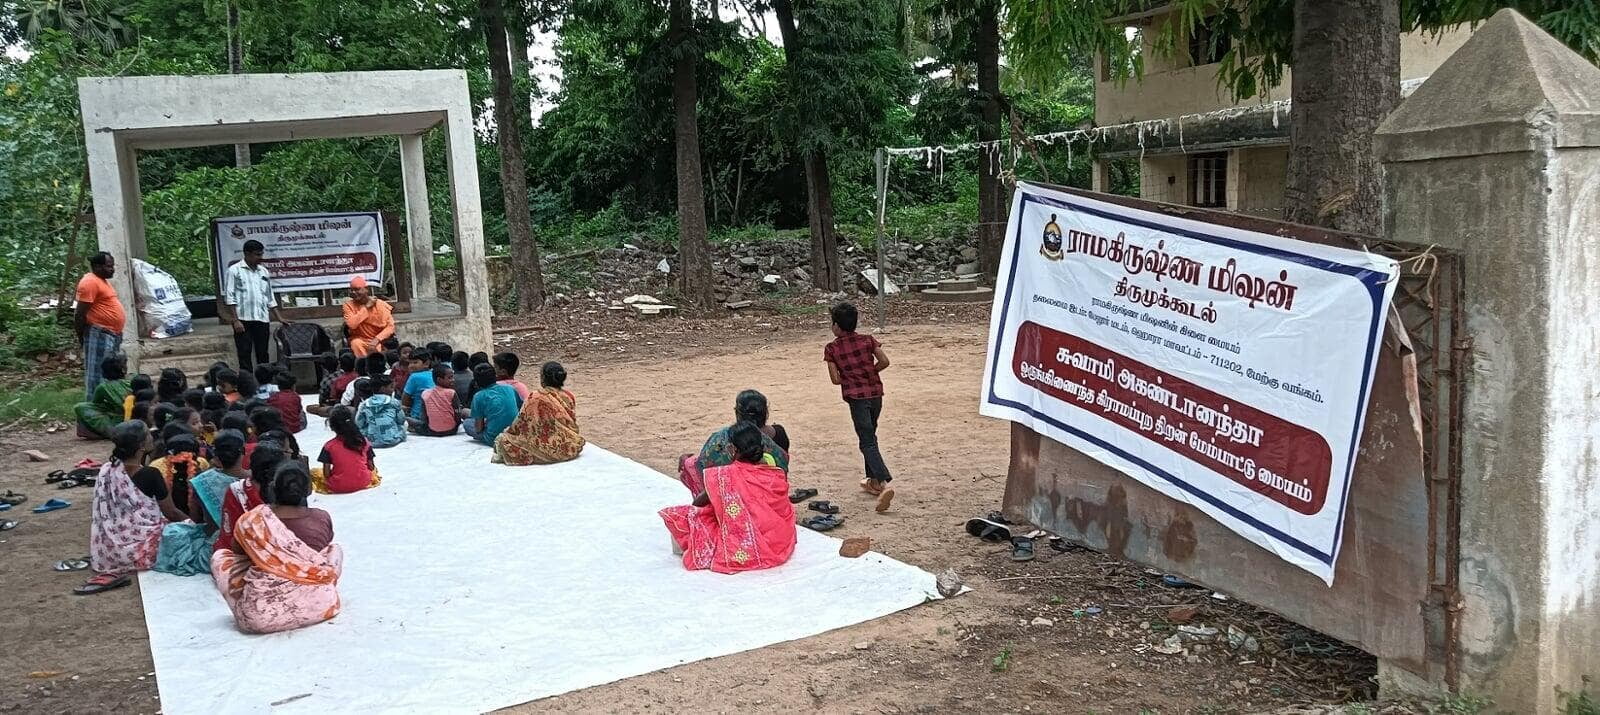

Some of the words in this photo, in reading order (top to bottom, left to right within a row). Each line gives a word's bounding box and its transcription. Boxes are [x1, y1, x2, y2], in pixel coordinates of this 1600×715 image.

[1067, 229, 1203, 286] ராமகிருஷ்ண
[1208, 258, 1298, 310] மிஷன்
[1114, 277, 1217, 323] திருமுக்கூடல்
[1032, 294, 1068, 310] தலைமை
[1164, 338, 1201, 359] மாவட்டம்
[1210, 354, 1244, 377] 711202,
[1246, 367, 1279, 390] மேற்கு
[1281, 382, 1324, 403] வங்கம்.
[1091, 297, 1139, 320] ராமகிருஷ்ண
[1140, 312, 1178, 332] மிஷனின்
[1179, 325, 1207, 342] கிளை
[1208, 336, 1240, 354] மையம்
[1020, 361, 1095, 404] ஒருங்கிணைந்த
[1096, 389, 1153, 431] கிராமப்புற
[1154, 415, 1188, 446] திறன்
[1189, 431, 1256, 480] மேம்பாட்டு
[1258, 467, 1312, 503] மையம்
[1056, 347, 1115, 383] சுவாமி
[1117, 368, 1264, 447] அகண்டானந்தா
